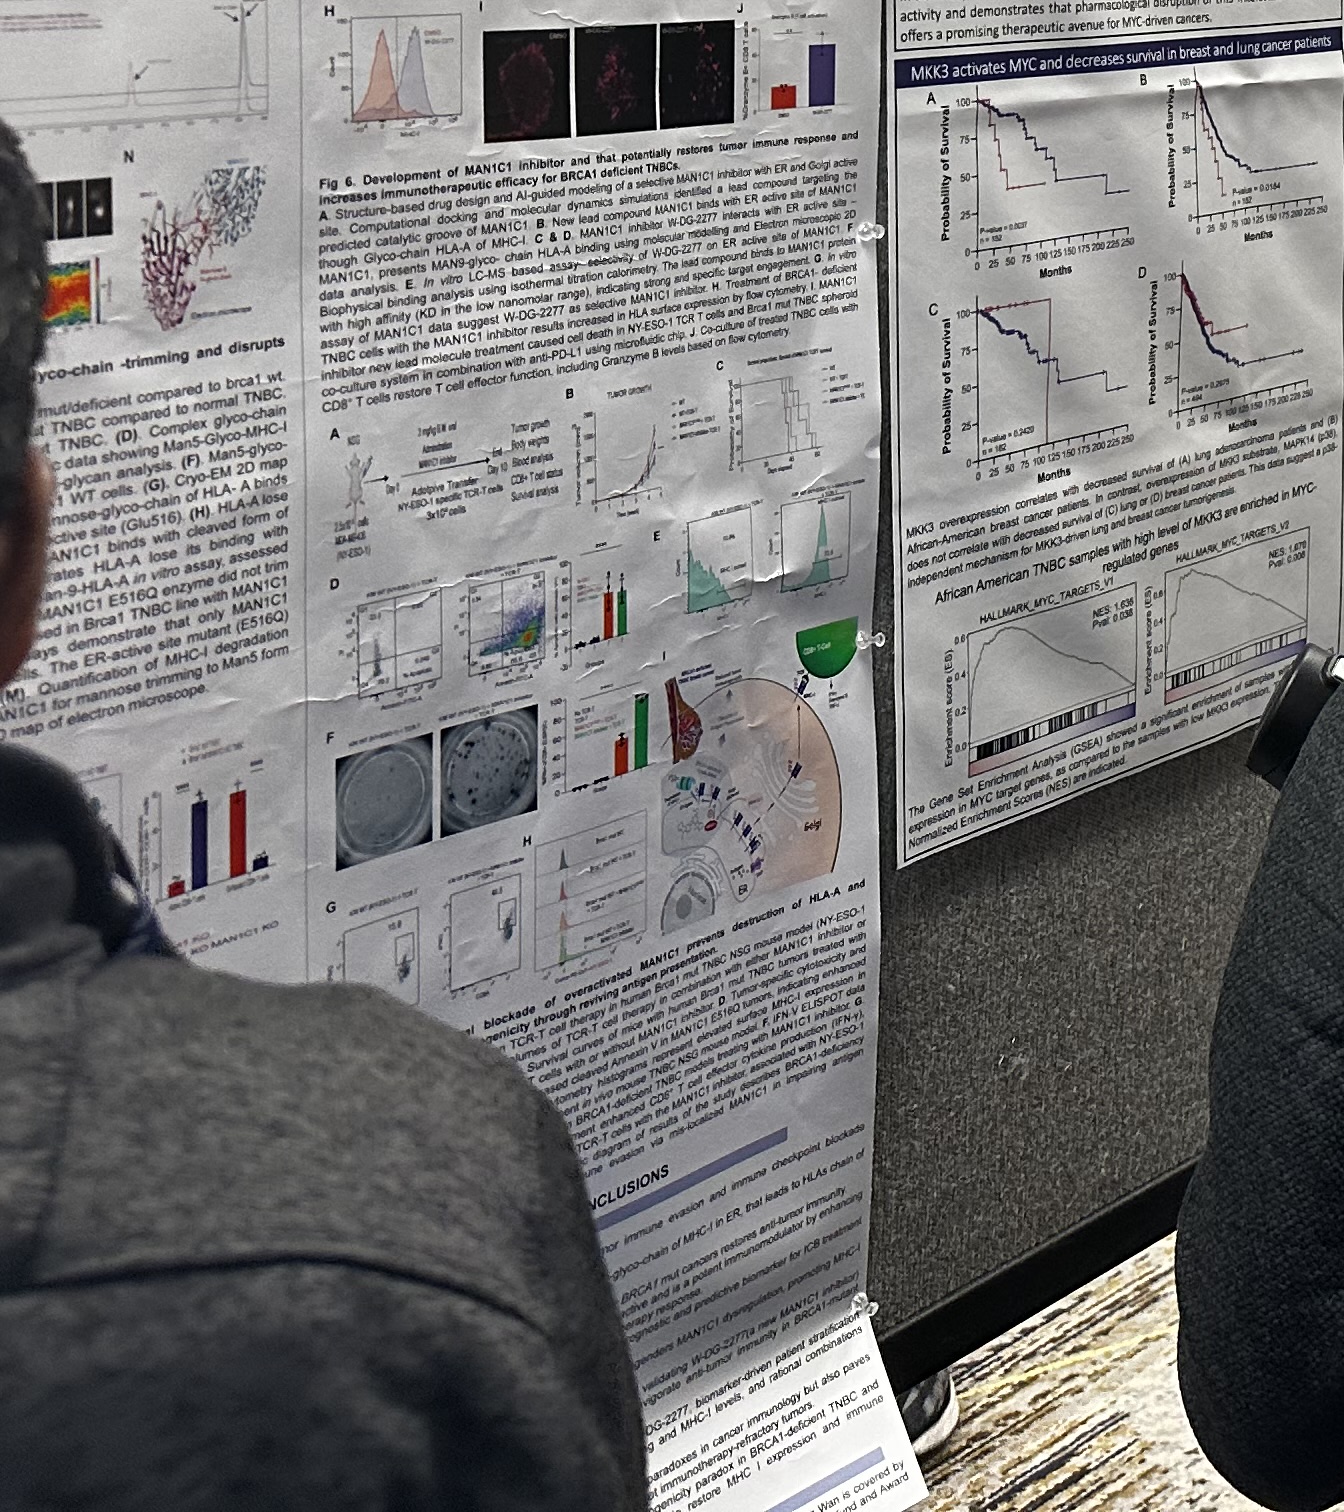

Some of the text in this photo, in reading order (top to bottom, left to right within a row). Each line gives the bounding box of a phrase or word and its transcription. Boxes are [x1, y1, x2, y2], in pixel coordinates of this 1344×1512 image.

[900, 13, 1212, 43] offers a promising therapeutic avenue for MYC-driven cancers.
[911, 34, 1332, 81] MKK3 activates MYC and decreases survival in breast and lung cancer patients
[926, 92, 937, 105] A
[1139, 74, 1148, 86] B
[940, 105, 952, 241] Probability of Survival
[1039, 264, 1073, 279] Months
[196, 343, 222, 359] and
[227, 336, 286, 355] disrupts
[934, 584, 974, 606] African
[974, 568, 1030, 594] American
[1031, 556, 1066, 577] TNBC
[1068, 545, 1110, 567] samples
[1111, 536, 1132, 553] with
[1133, 529, 1155, 547] high
[1157, 520, 1180, 539] level
[1181, 516, 1193, 532] of
[1193, 508, 1223, 532] MKK3
[1223, 505, 1238, 519] are
[1239, 491, 1279, 513] enriched
[1281, 489, 1290, 501] in
[590, 1164, 670, 1211] NCLUSIONS
[695, 1461, 735, 1494] paradox
[749, 1408, 827, 1459] BRCA1-deficient
[829, 1391, 858, 1413] TNBC
[861, 1379, 880, 1397] and
